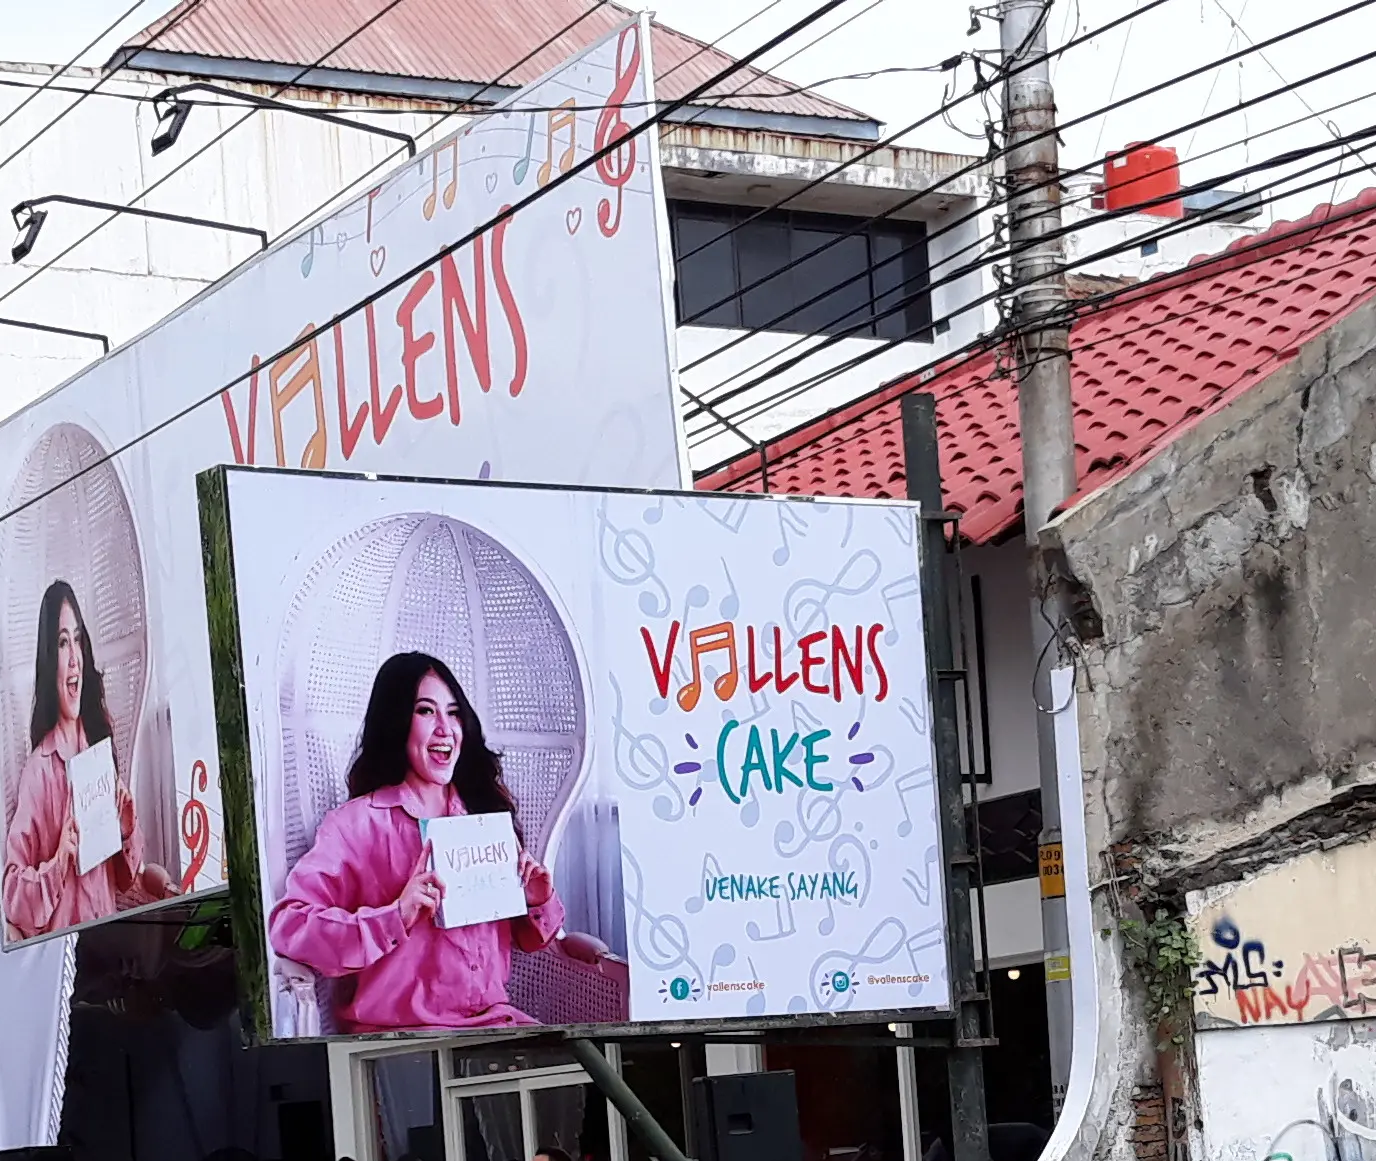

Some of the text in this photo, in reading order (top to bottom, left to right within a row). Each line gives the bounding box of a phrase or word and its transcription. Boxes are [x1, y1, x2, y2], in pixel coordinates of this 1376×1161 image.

[717, 719, 833, 804] CAKE
[787, 870, 859, 901] SAYANG
[1236, 980, 1311, 1024] NAY
